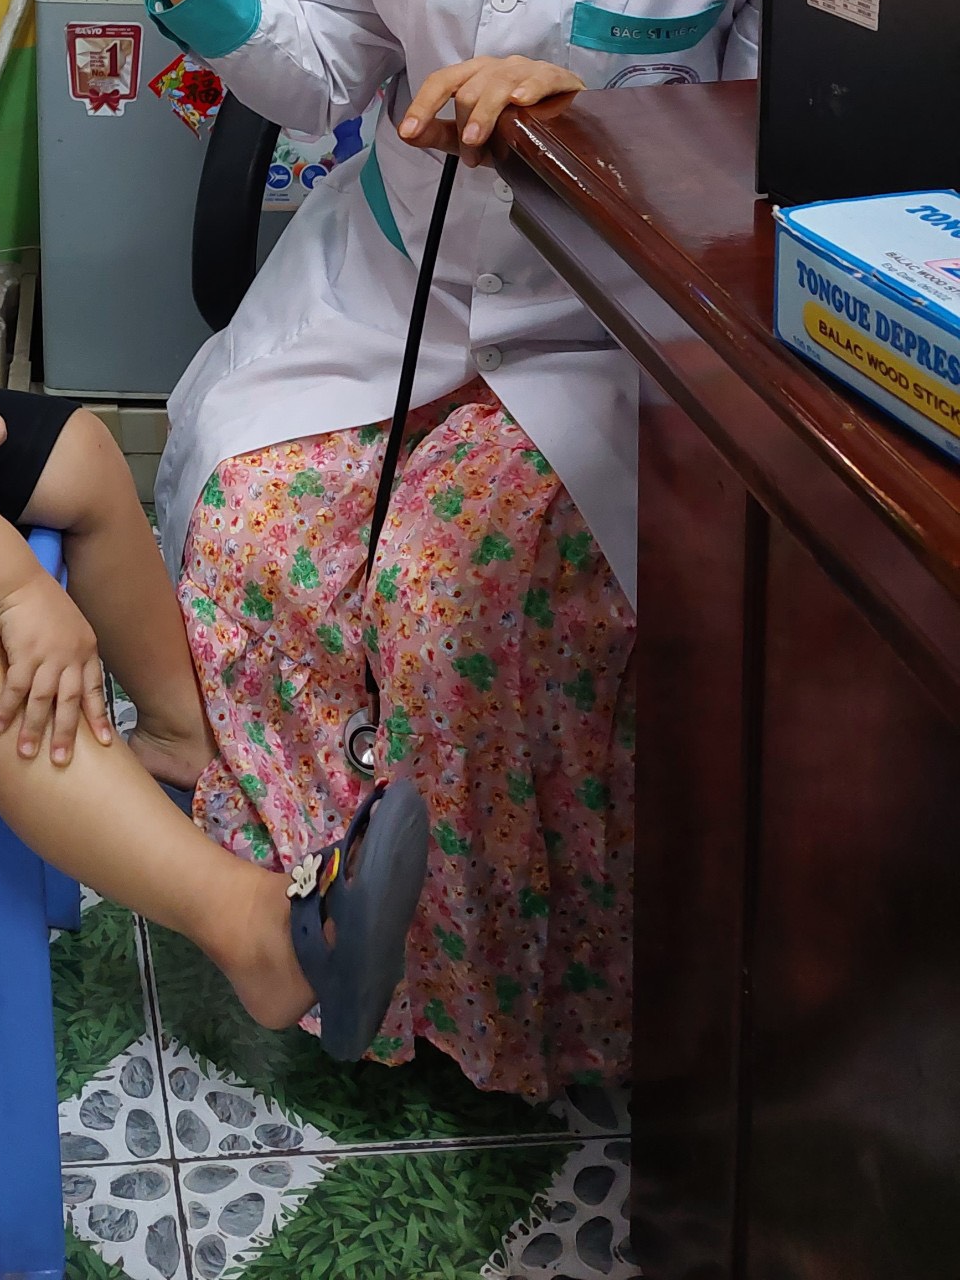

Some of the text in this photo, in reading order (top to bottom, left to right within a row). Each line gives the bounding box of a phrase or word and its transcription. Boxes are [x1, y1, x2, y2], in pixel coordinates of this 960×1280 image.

[75, 27, 103, 35] SANYO
[106, 42, 120, 77] 1
[797, 258, 871, 332] TONGUE
[818, 319, 863, 360] BALAC
[867, 351, 910, 390] WOOD
